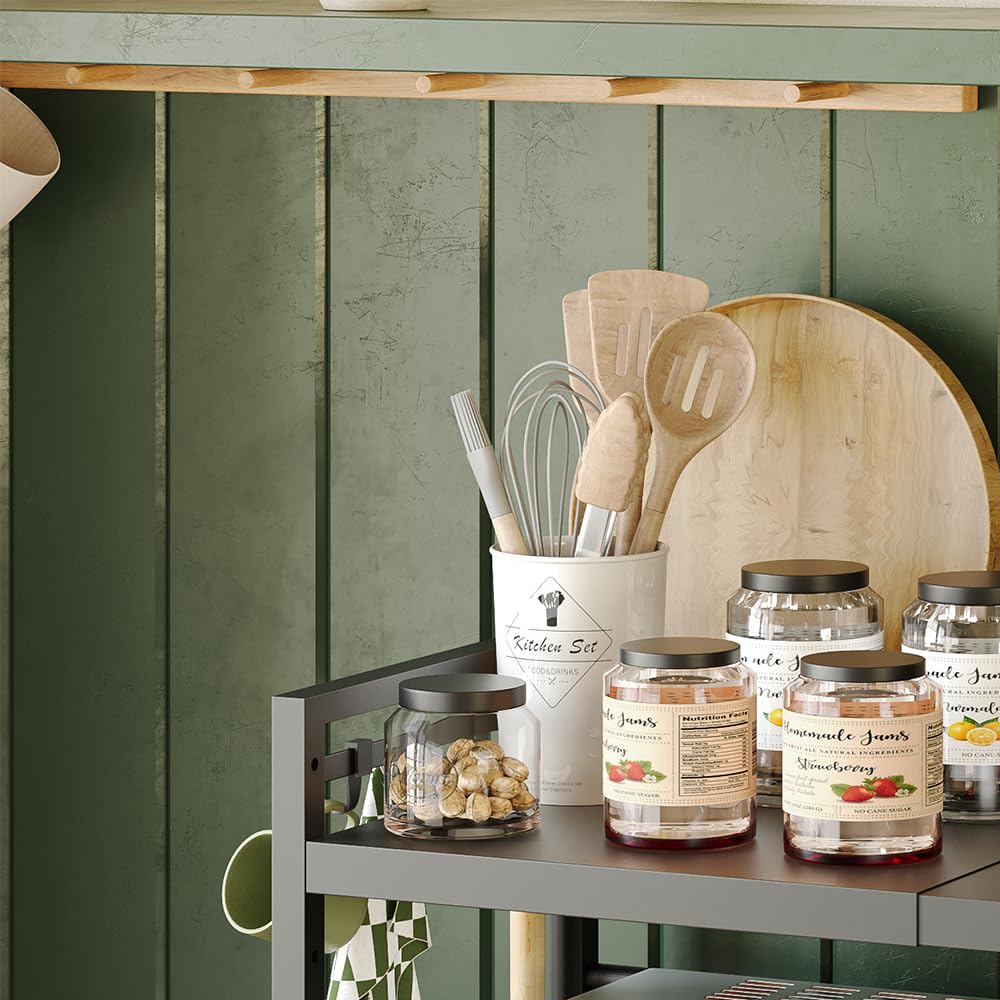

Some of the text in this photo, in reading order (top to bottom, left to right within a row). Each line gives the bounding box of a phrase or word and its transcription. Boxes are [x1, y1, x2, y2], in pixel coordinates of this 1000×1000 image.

[513, 635, 598, 654] Kitchen Set
[528, 666, 580, 676] OOD&DRINKS
[616, 712, 657, 728] Jams
[682, 714, 726, 722] Nutrition
[784, 720, 911, 746] Homemade Jams
[859, 748, 914, 756] INGREDIENTS
[796, 756, 877, 776] Strawberry
